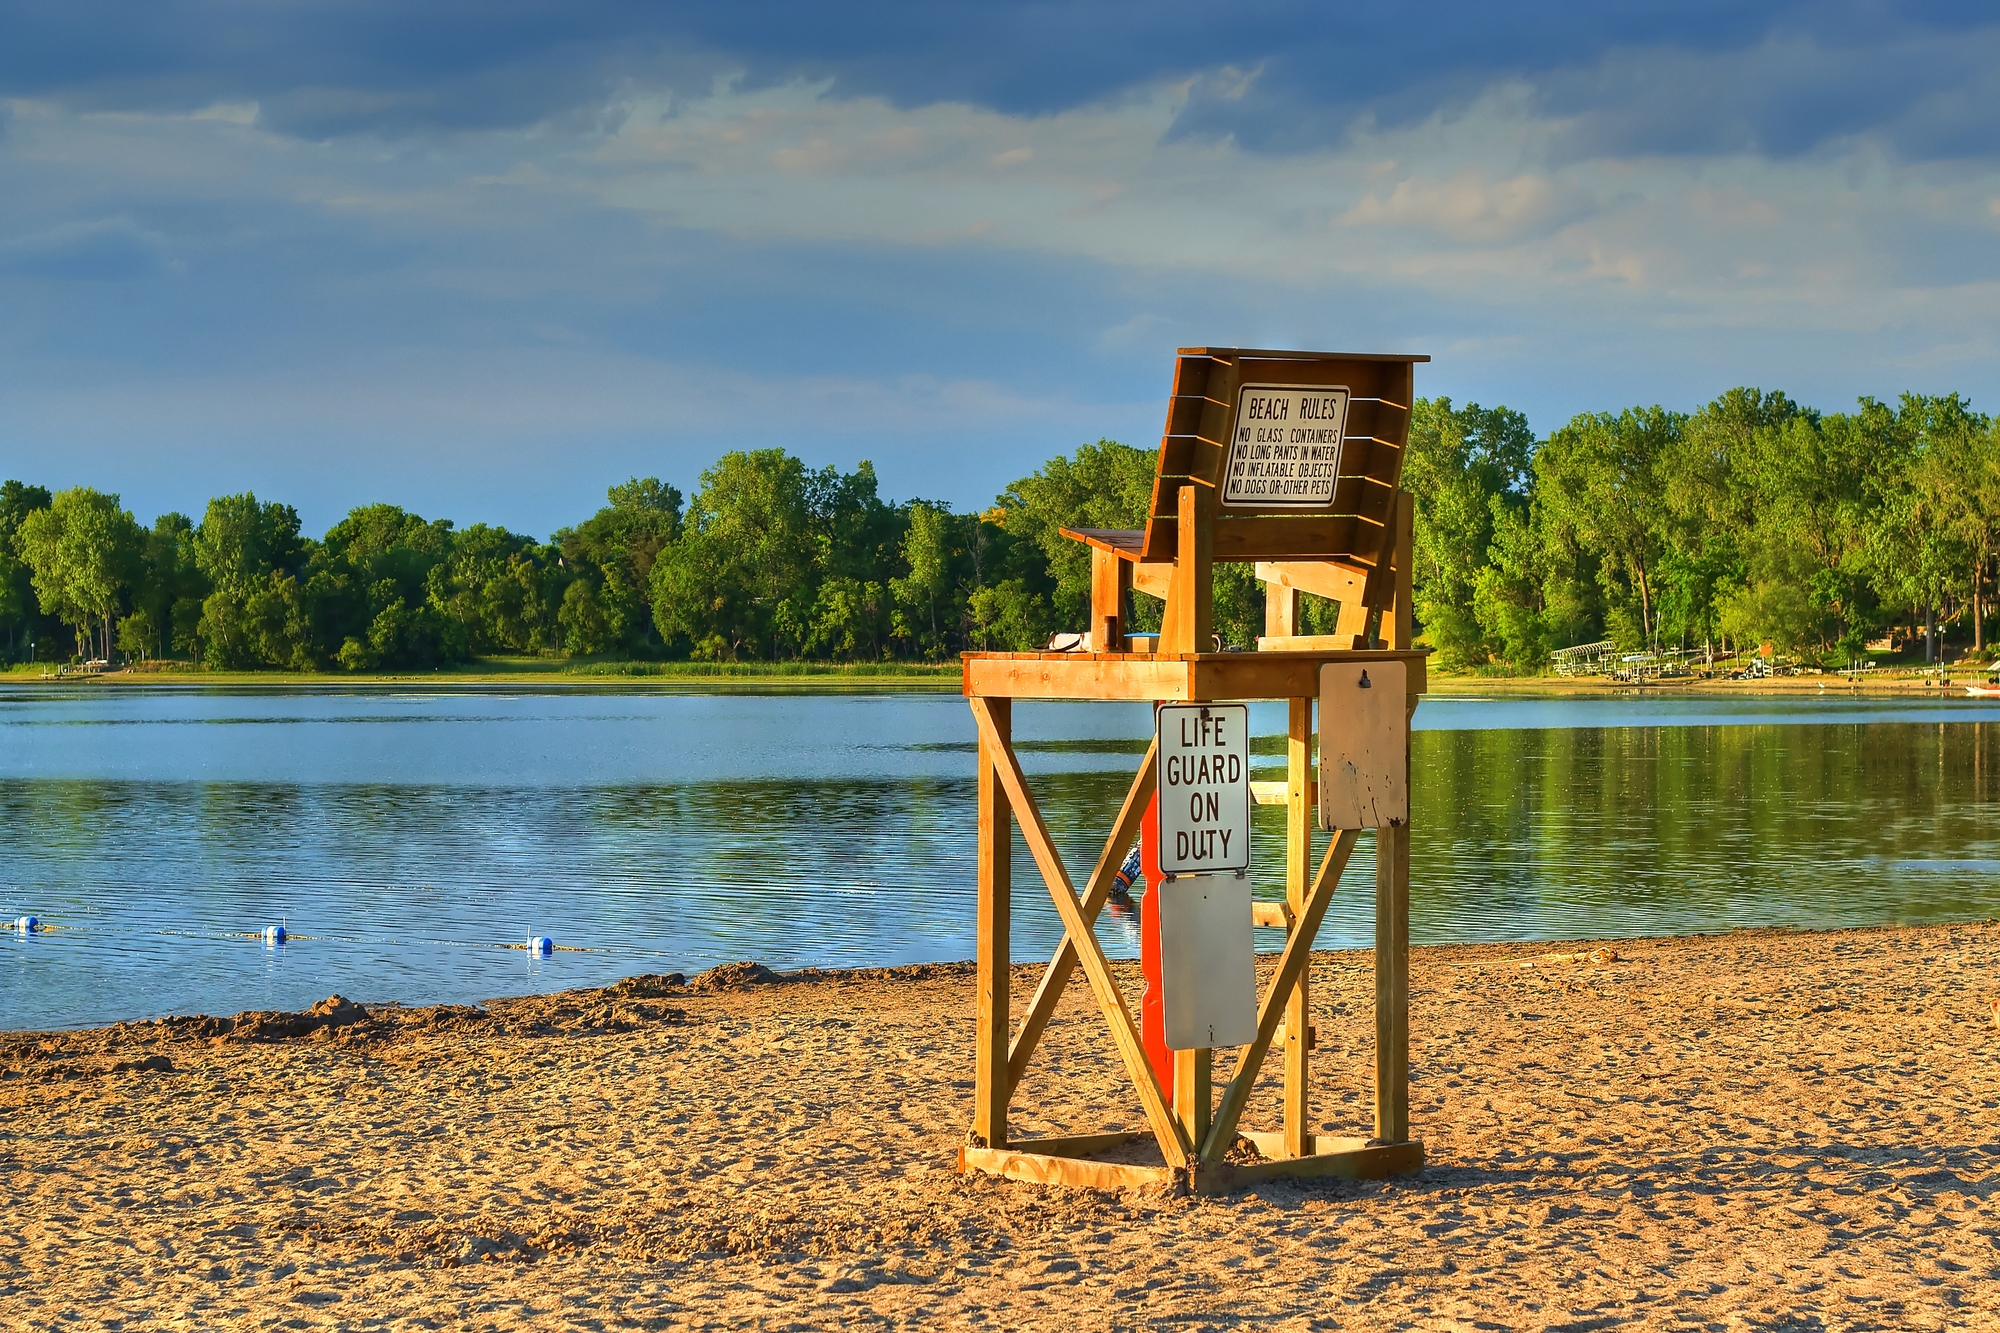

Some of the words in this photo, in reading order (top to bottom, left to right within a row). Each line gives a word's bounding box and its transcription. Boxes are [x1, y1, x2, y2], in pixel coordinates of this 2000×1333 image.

[1249, 398, 1289, 420] BEACH
[1300, 398, 1336, 420] RULES
[1238, 427, 1250, 442] NO
[1257, 428, 1284, 442] GLASS
[1290, 428, 1338, 444] CONTAINERS
[1236, 445, 1248, 460] NO
[1250, 445, 1271, 460] LONG
[1273, 446, 1298, 460] PANTS
[1300, 446, 1309, 460] IN
[1311, 446, 1335, 460] WATER
[1233, 462, 1245, 477] NO
[1248, 462, 1295, 477] INFLATABLE
[1298, 463, 1333, 477] OBJECTS
[1230, 479, 1242, 494] NO
[1245, 479, 1267, 494] DOGS
[1283, 480, 1308, 494] OTHER
[1311, 480, 1331, 495] PETS
[1181, 716, 1226, 747] LIFE
[1167, 754, 1241, 786] GUARD
[1190, 792, 1219, 823] ON
[1176, 828, 1232, 861] DUTY
